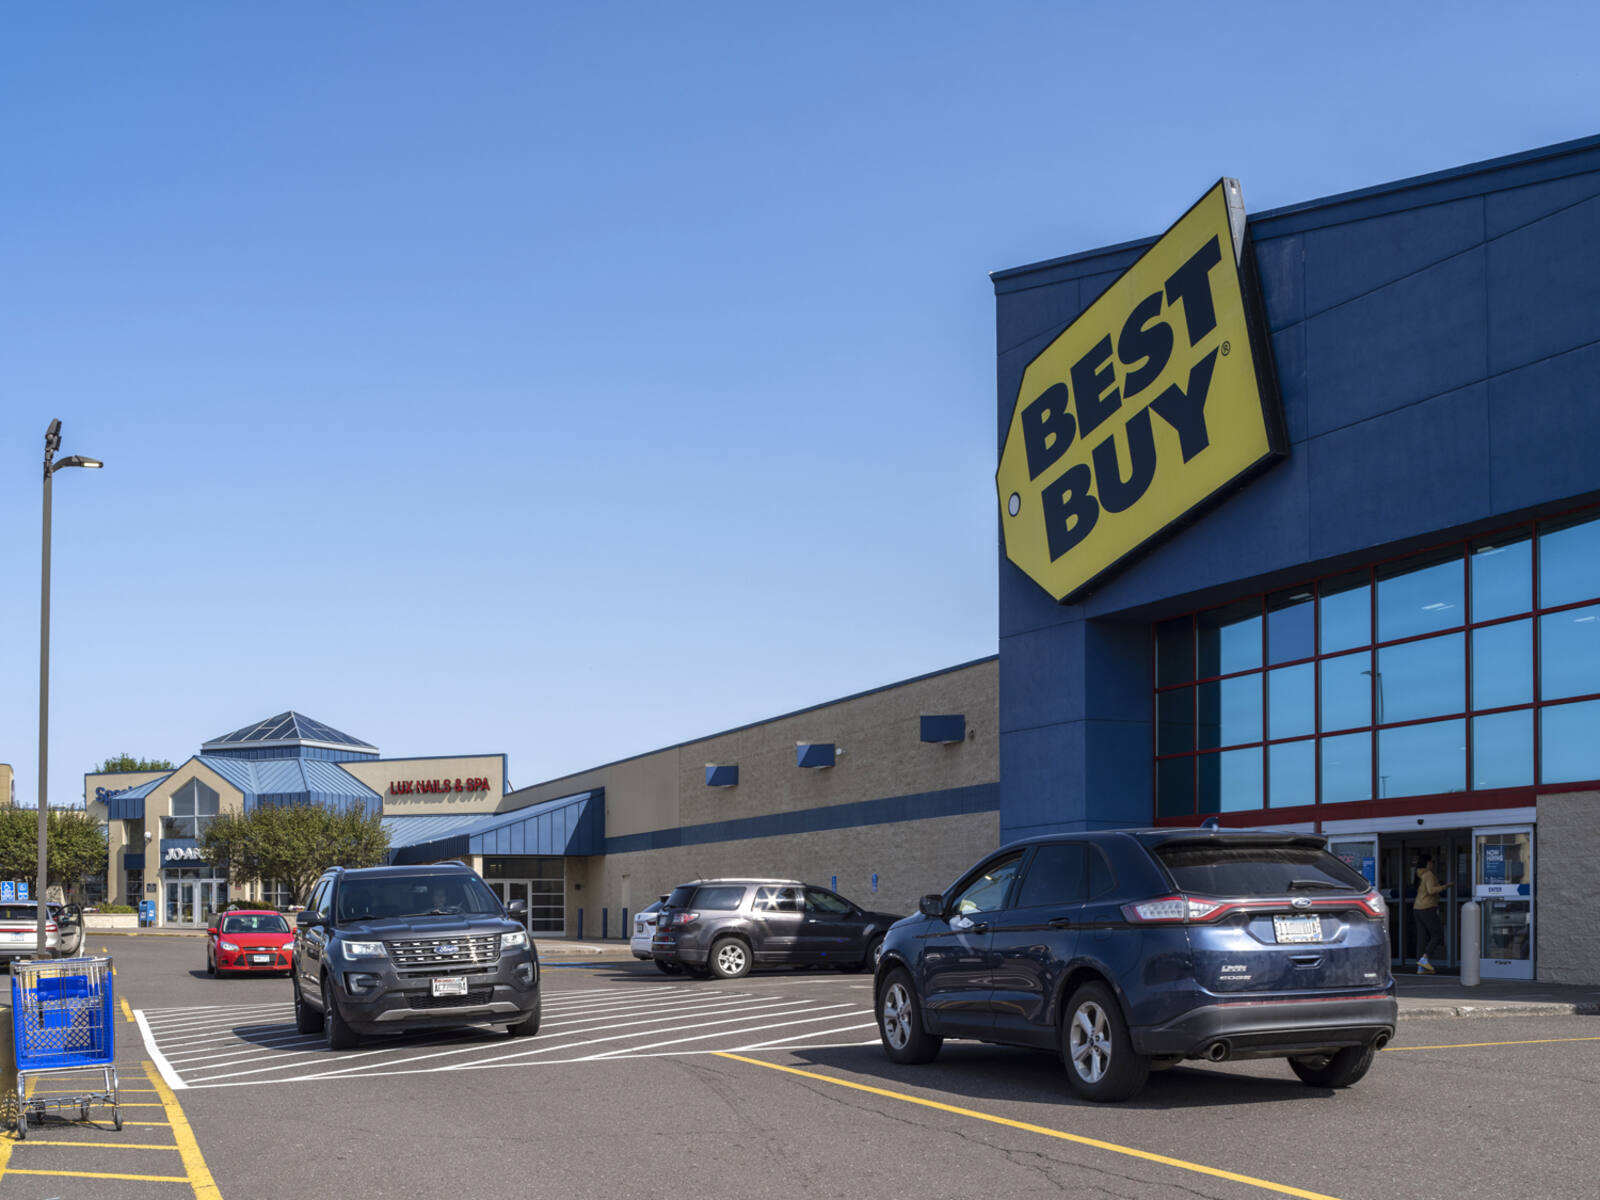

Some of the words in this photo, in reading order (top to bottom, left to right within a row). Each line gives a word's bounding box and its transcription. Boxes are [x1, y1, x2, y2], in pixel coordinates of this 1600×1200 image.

[1021, 234, 1222, 482] BEST
[1041, 345, 1221, 563] BUY
[390, 781, 414, 795] LUX
[416, 779, 451, 794] NAILS
[454, 778, 463, 793] &
[466, 777, 490, 792] SPA
